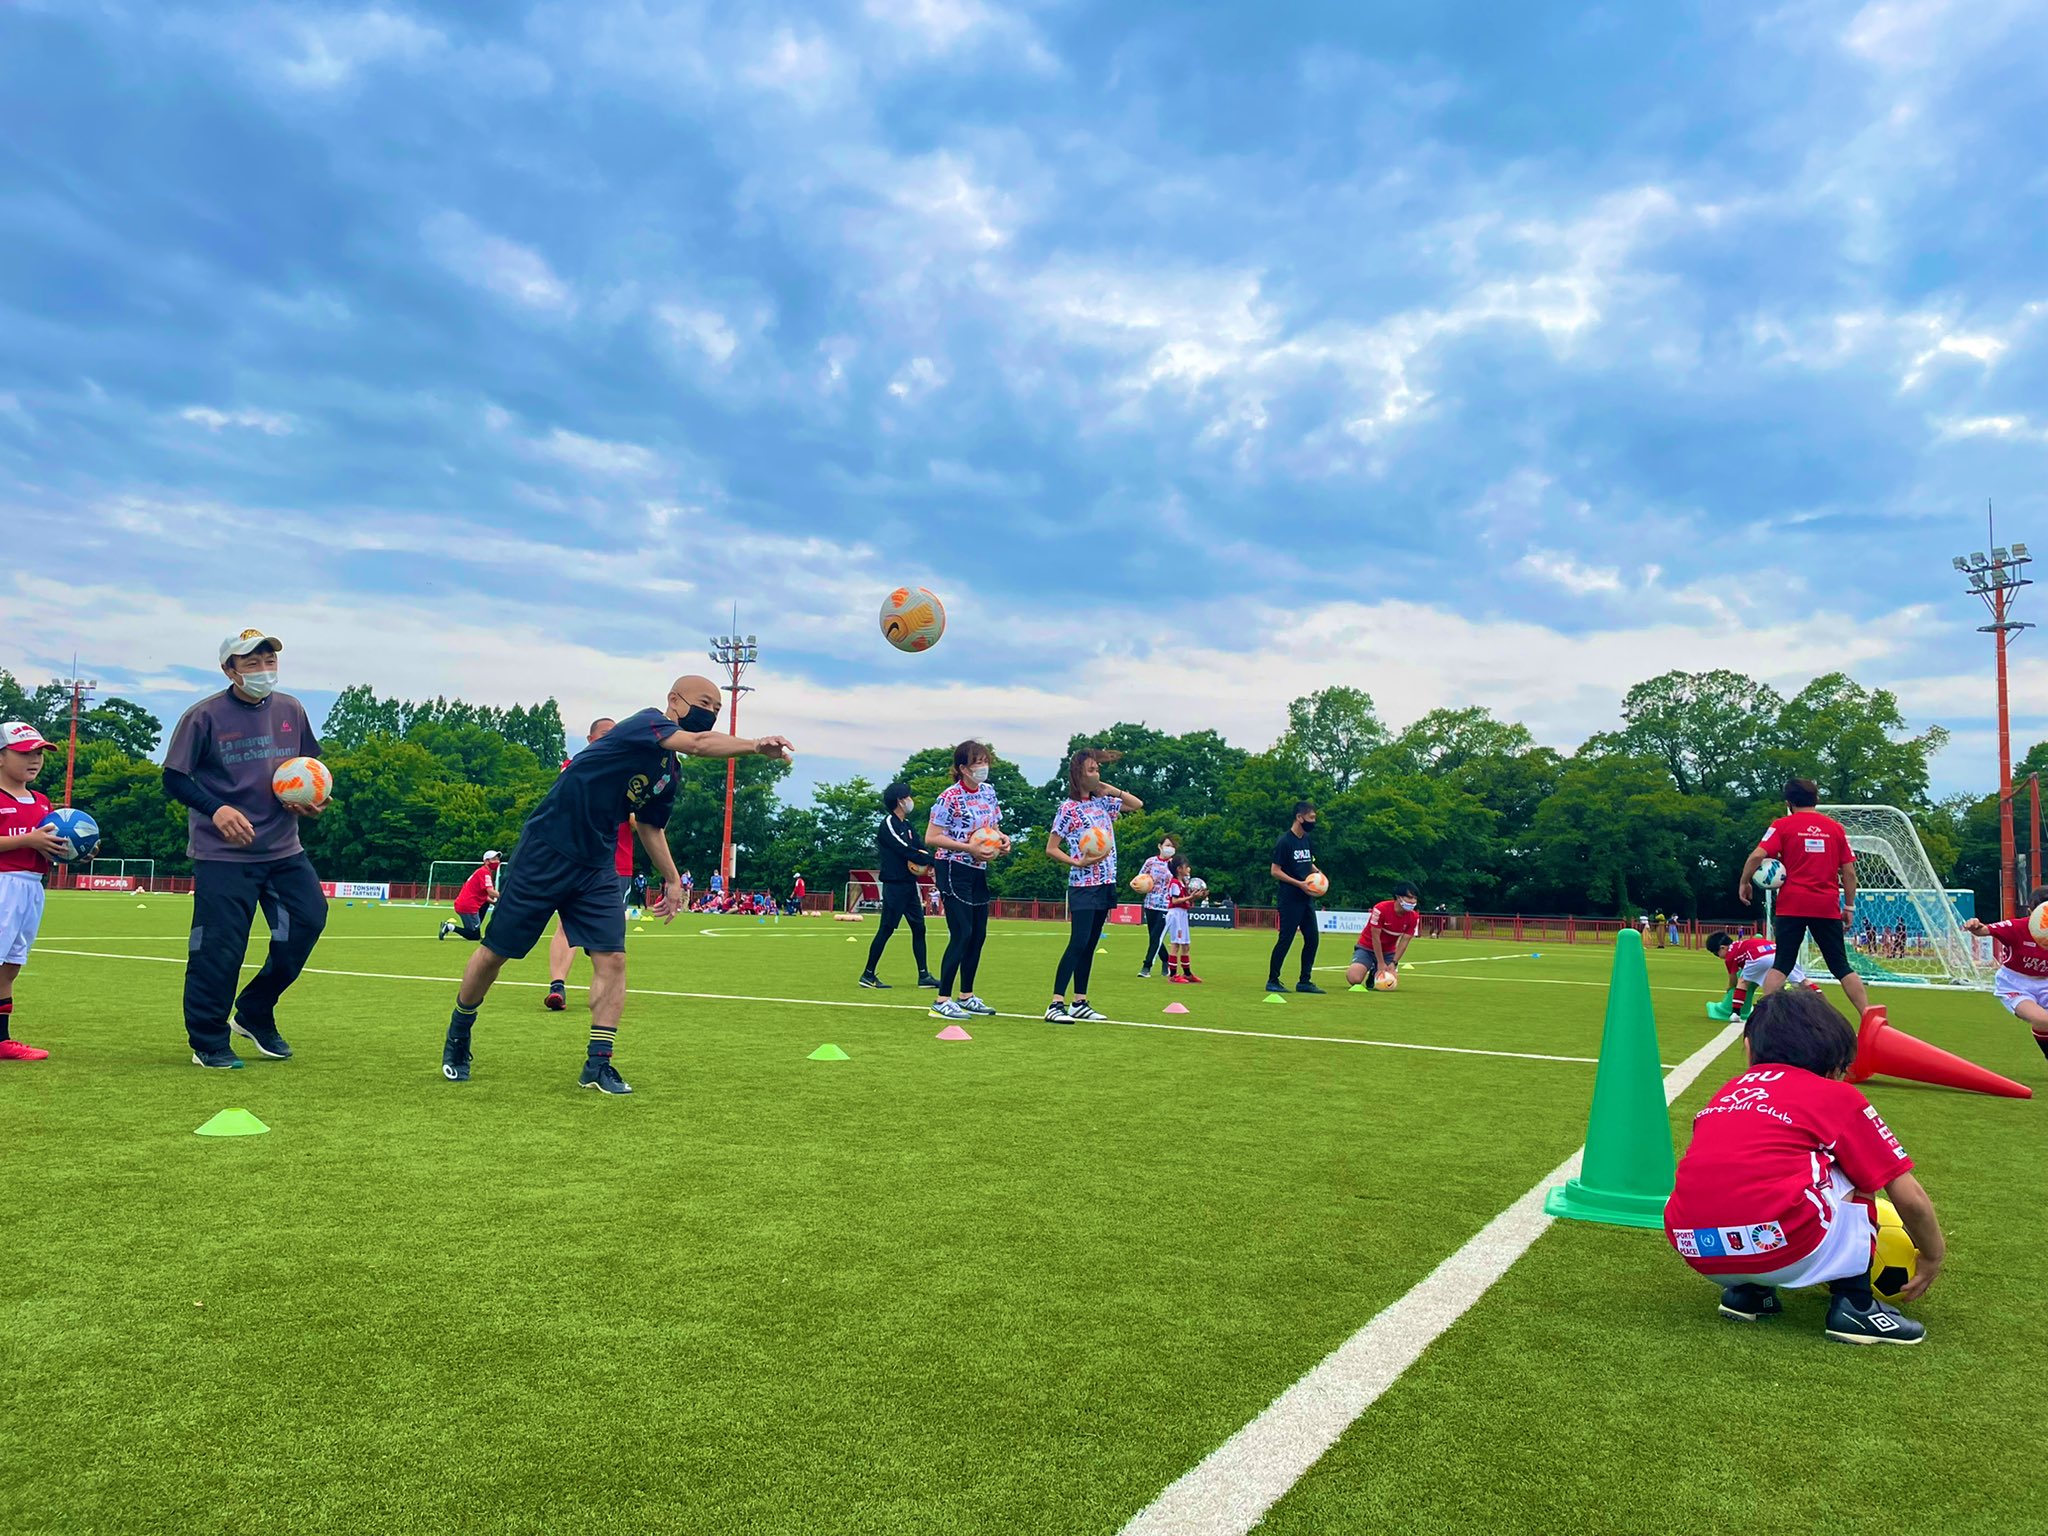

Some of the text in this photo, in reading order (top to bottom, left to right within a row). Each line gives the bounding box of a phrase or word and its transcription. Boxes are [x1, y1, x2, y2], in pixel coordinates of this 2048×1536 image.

[1189, 913, 1231, 922] FOOTBALL
[1736, 1071, 1785, 1085] RU
[1695, 1101, 1793, 1124] eart-full Club
[1675, 1231, 1695, 1240] SPORTS
